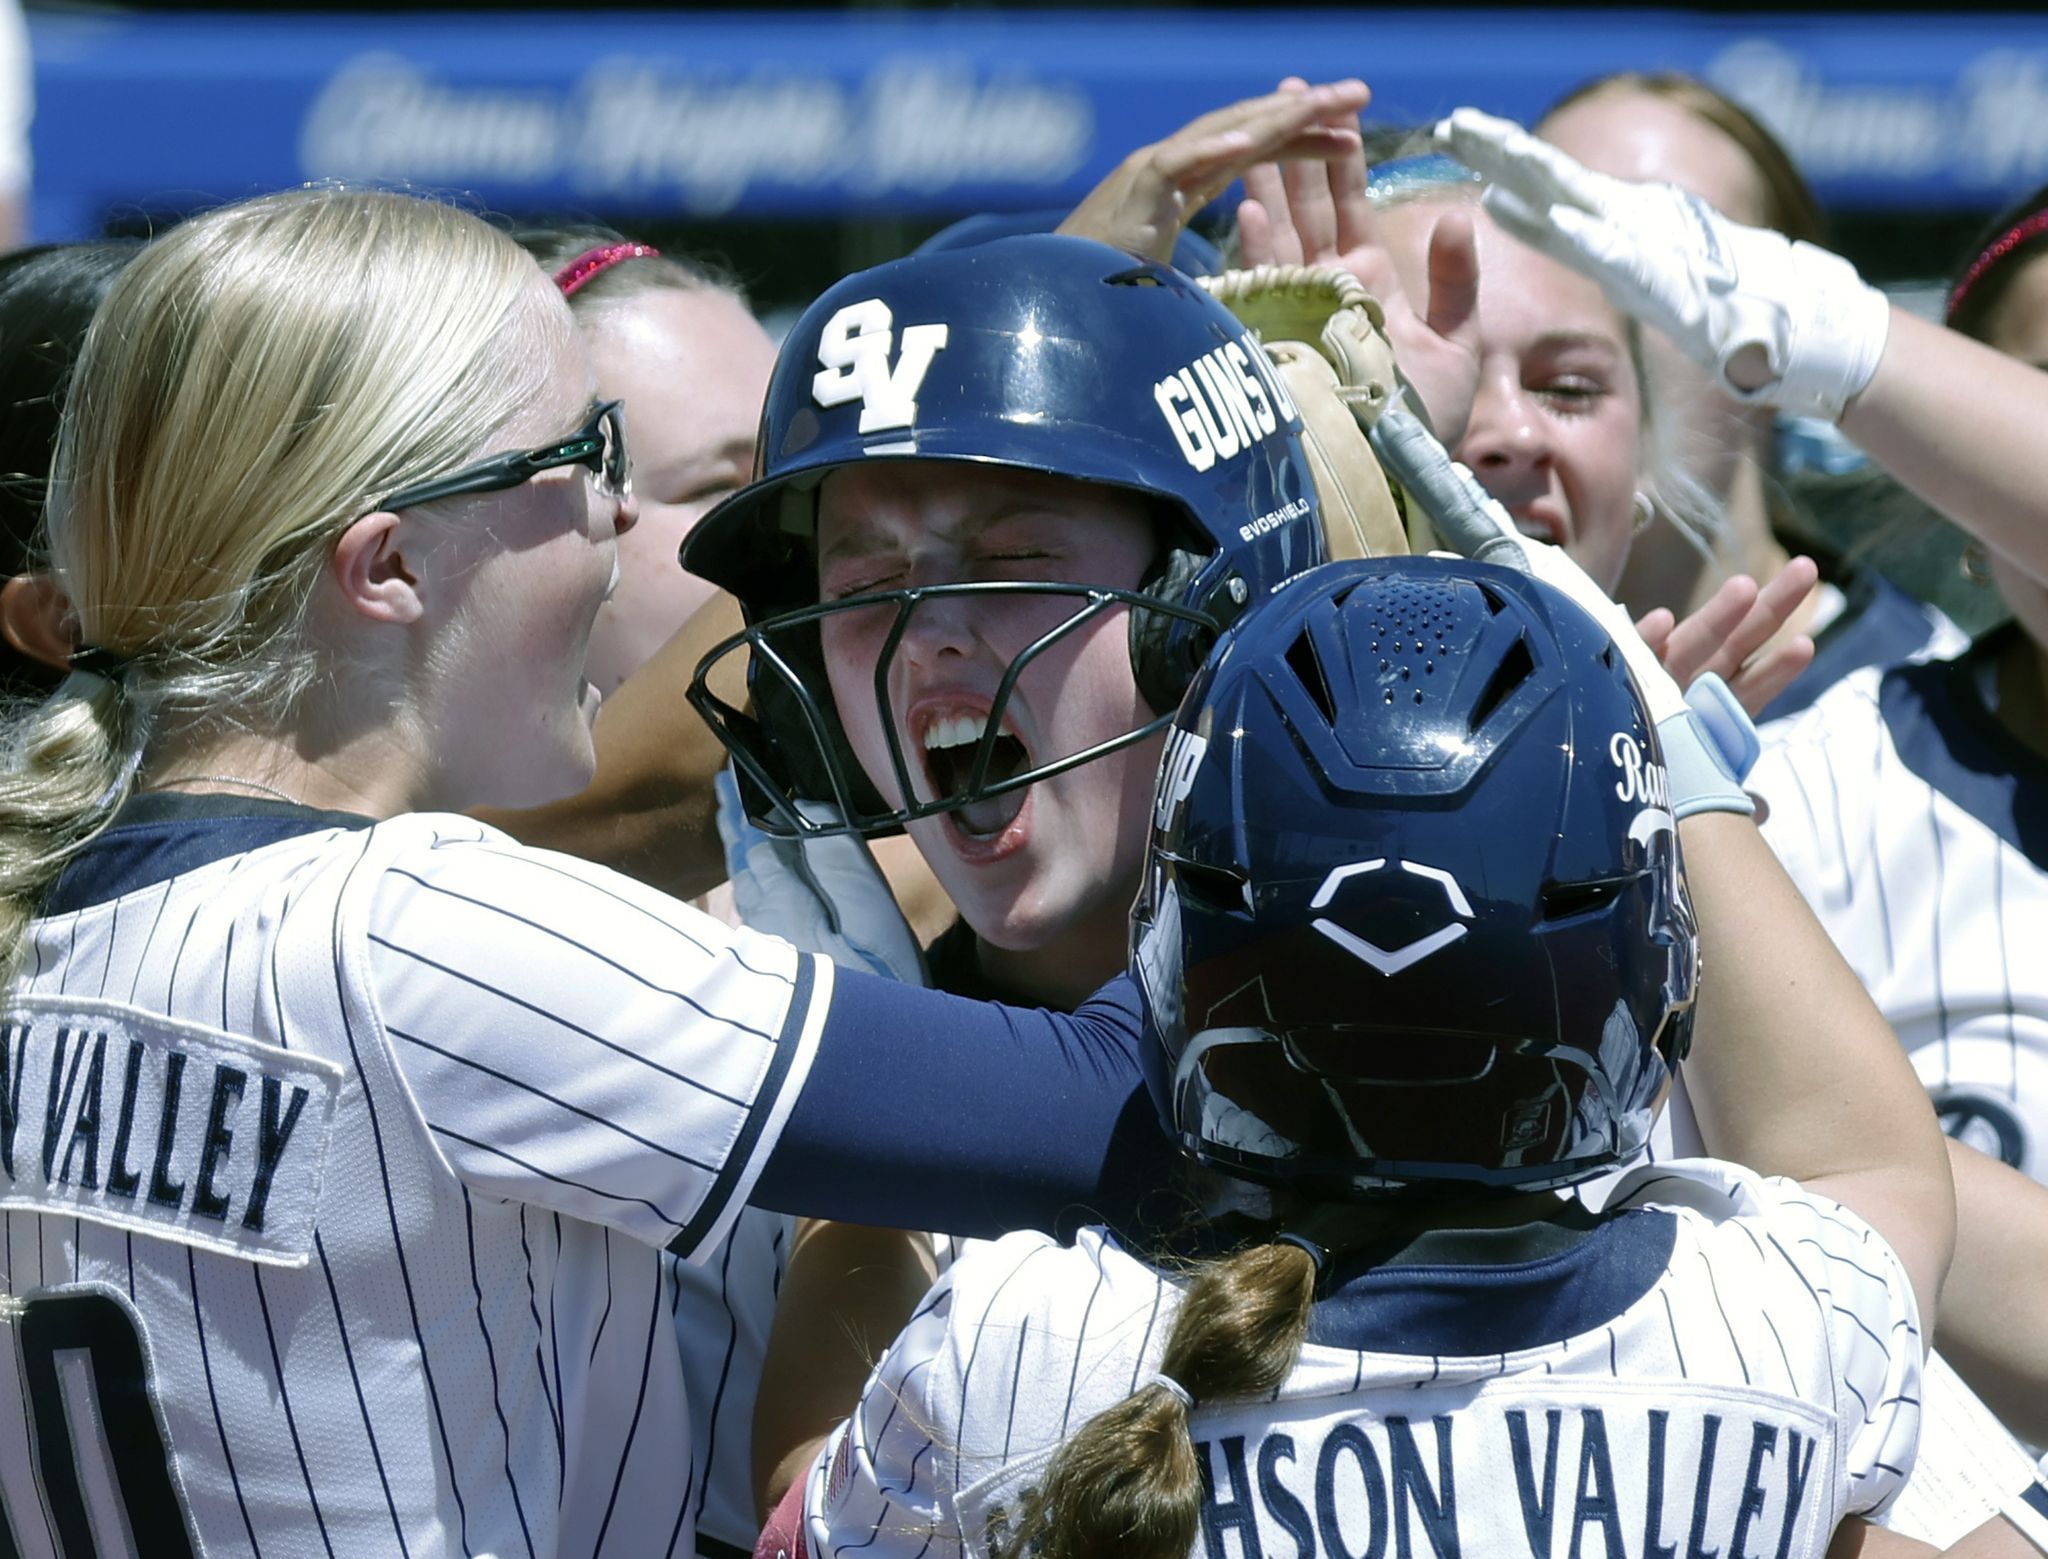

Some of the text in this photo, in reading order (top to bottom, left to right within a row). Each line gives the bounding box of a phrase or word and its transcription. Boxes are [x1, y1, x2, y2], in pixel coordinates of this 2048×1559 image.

[812, 298, 948, 434] SV
[1154, 328, 1299, 473] GUNS U
[42, 1027, 309, 1232] VALLEY
[1193, 1415, 1461, 1559] HSON
[1504, 1408, 1816, 1559] VALLEY
